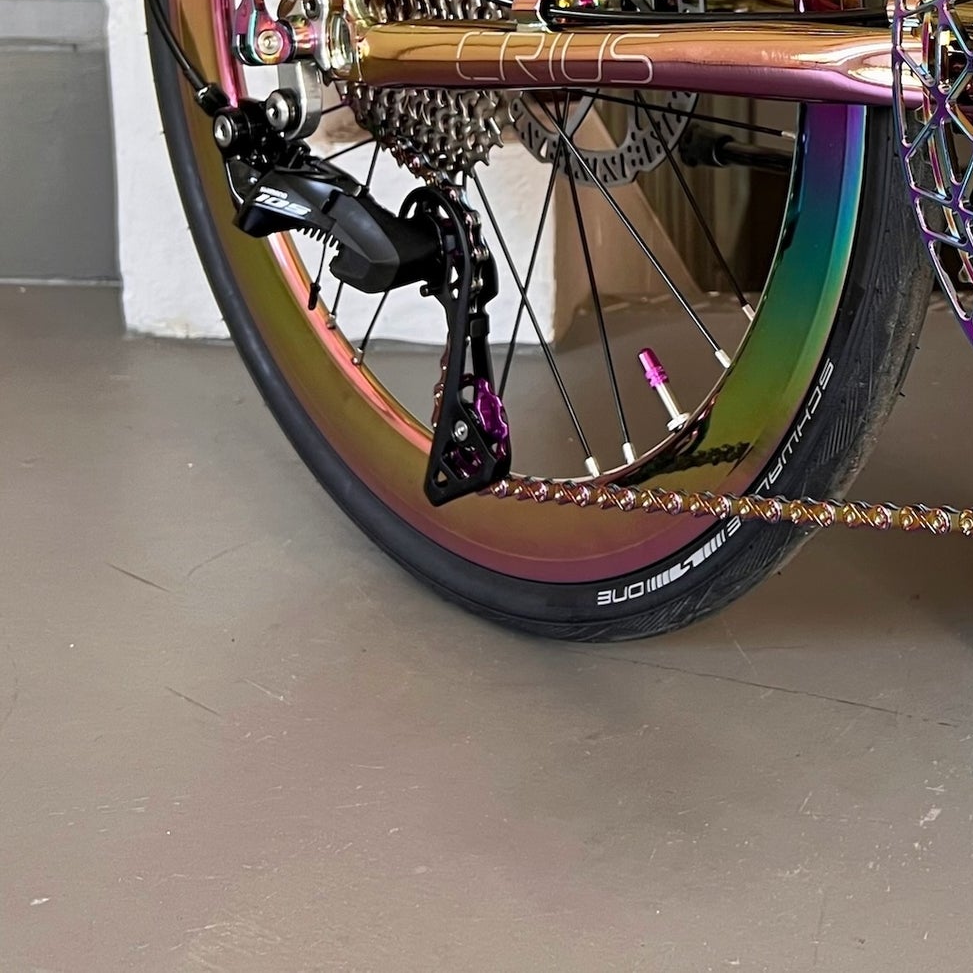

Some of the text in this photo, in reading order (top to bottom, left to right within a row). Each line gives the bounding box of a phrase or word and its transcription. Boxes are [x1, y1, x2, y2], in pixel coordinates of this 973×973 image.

[456, 31, 661, 84] CRIUS
[255, 194, 312, 216] 105
[598, 359, 834, 606] SCHWALE ONE
